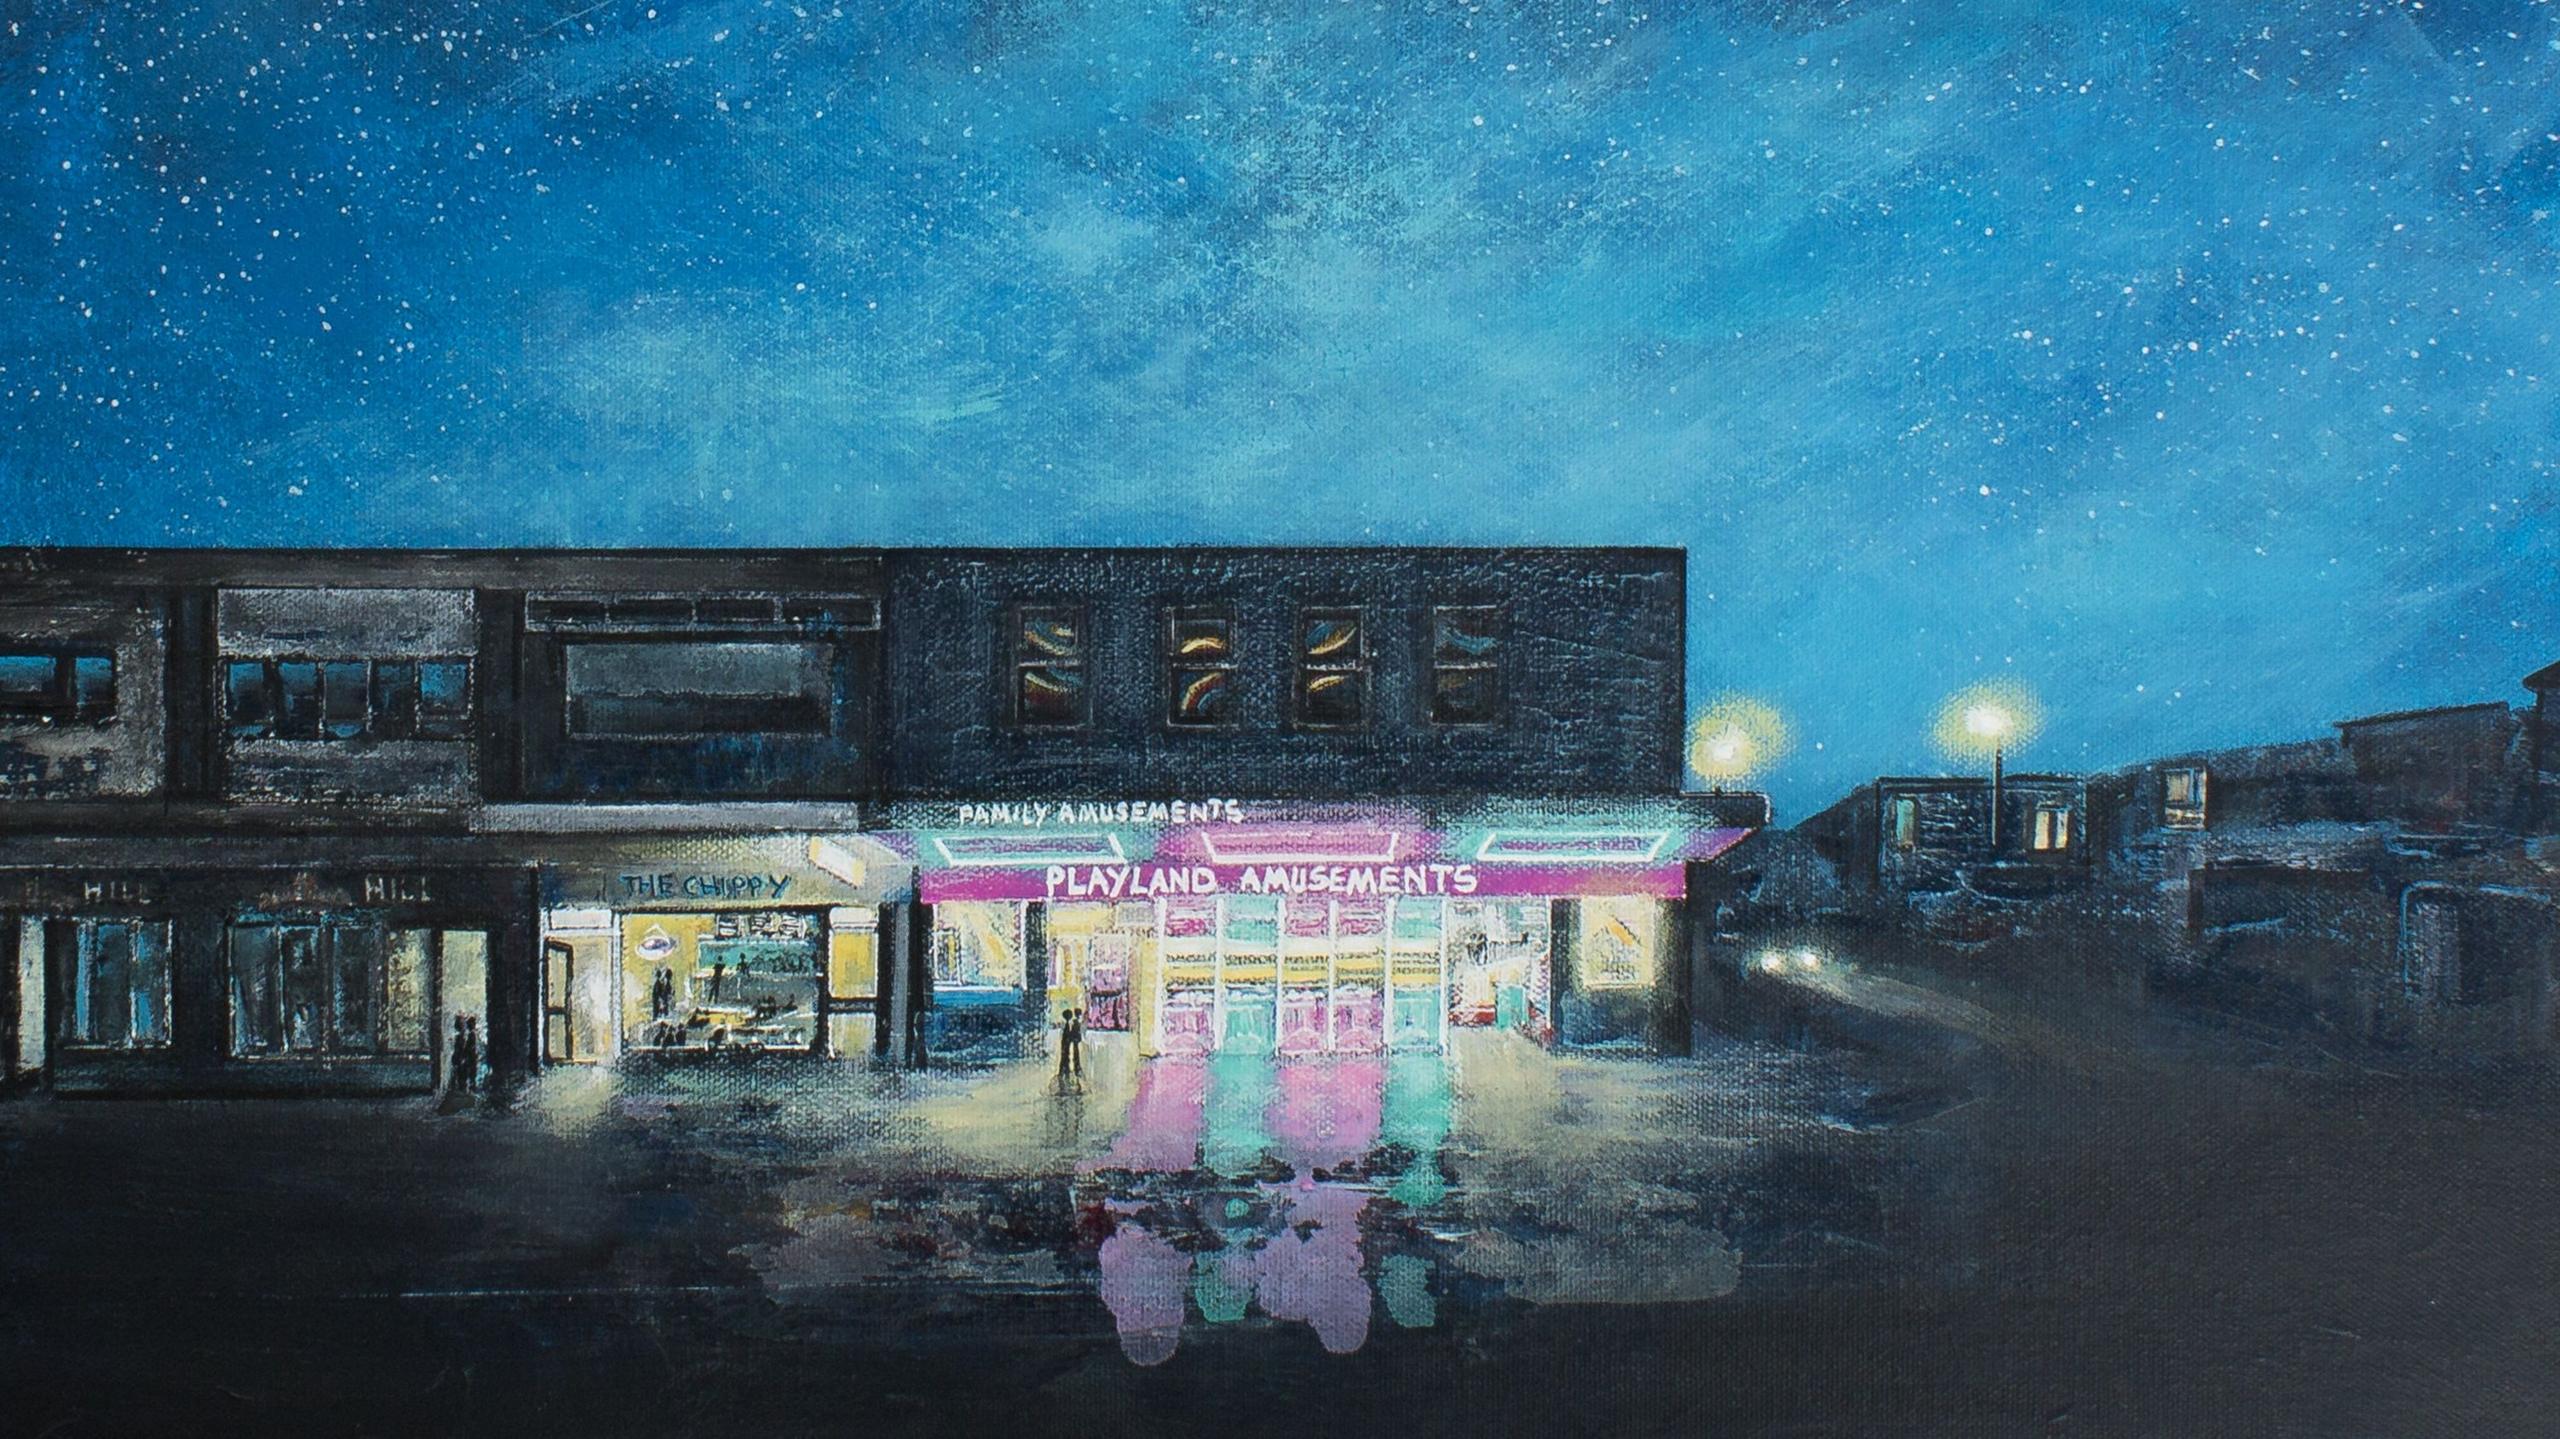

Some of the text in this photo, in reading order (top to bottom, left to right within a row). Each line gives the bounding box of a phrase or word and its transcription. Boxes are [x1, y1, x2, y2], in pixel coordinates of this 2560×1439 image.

[1060, 799, 1245, 824] AMUSEMENTS
[85, 881, 151, 904] HILL
[364, 876, 431, 902] HILL
[621, 873, 792, 899] THE CHIPPY
[1046, 864, 1478, 898] PLAYLAND AMUSEMENTS
